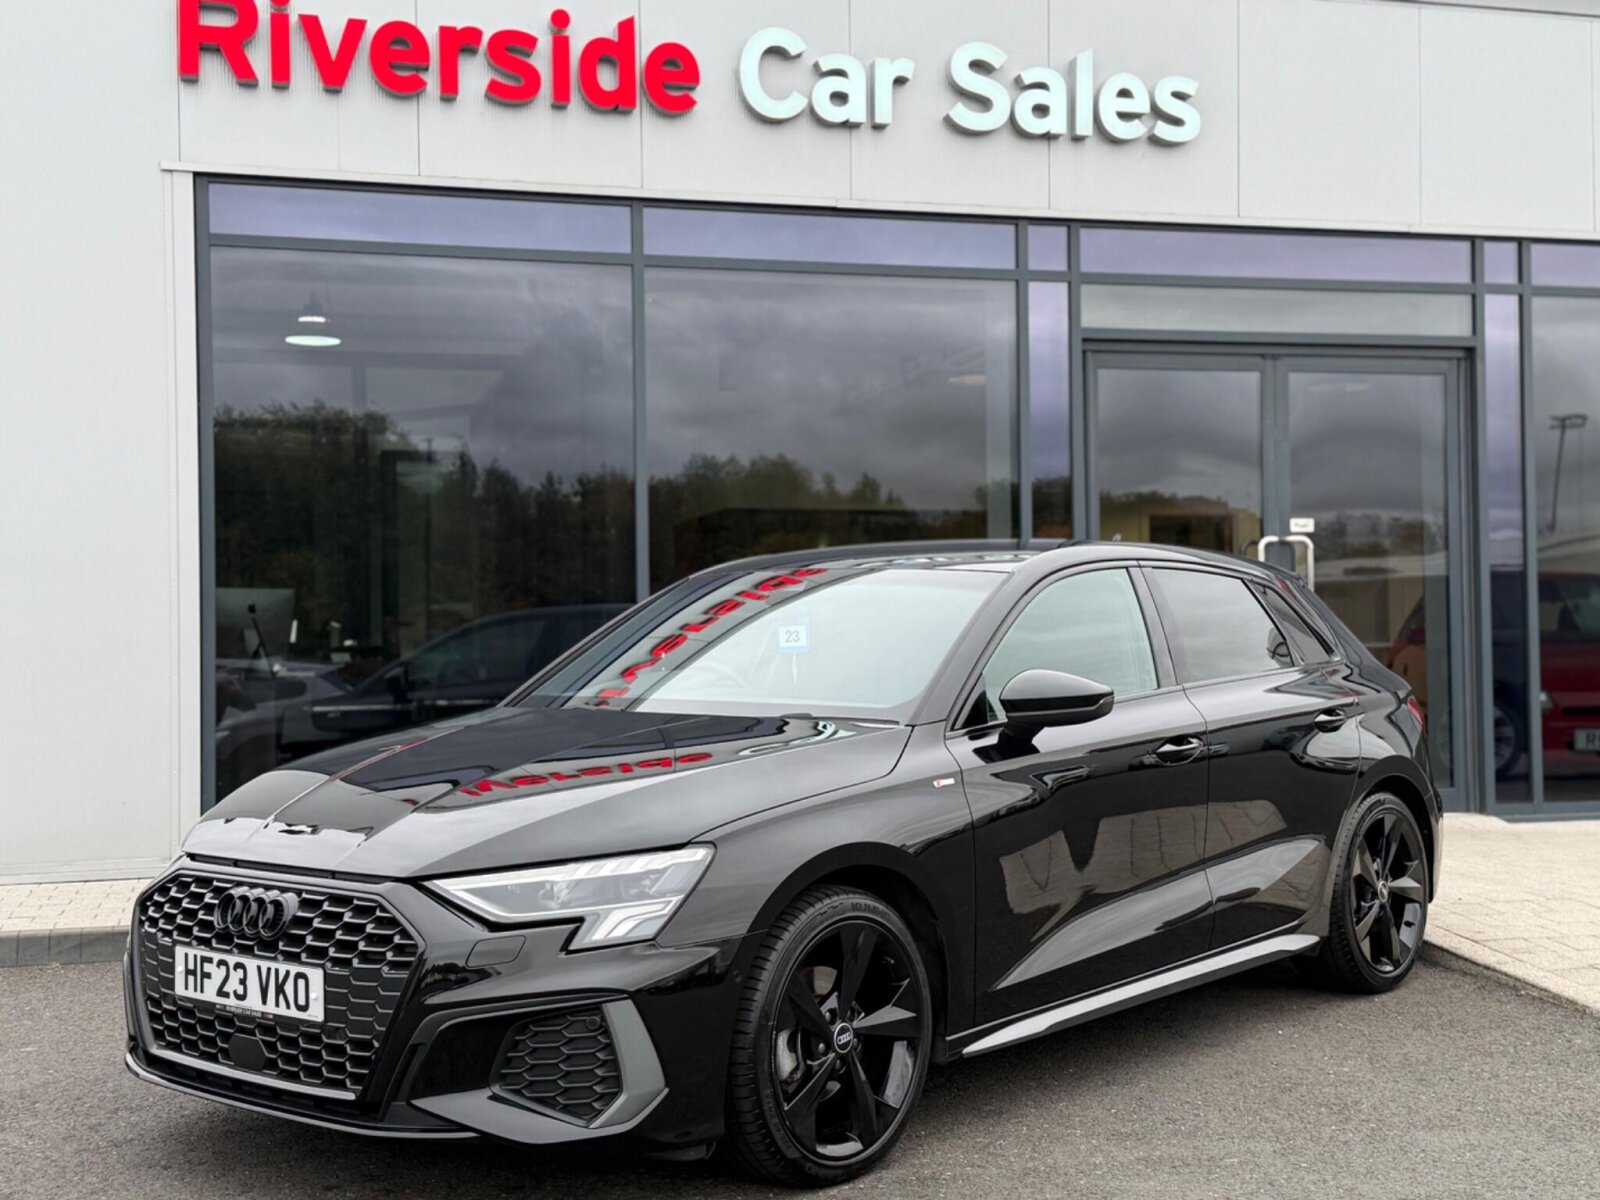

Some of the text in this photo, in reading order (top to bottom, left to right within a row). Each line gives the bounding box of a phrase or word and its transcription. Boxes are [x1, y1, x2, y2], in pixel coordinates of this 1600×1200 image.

[178, 0, 1201, 145] Riverside Car Sales
[784, 630, 800, 643] 23
[184, 952, 310, 1013] HF23 VKO
